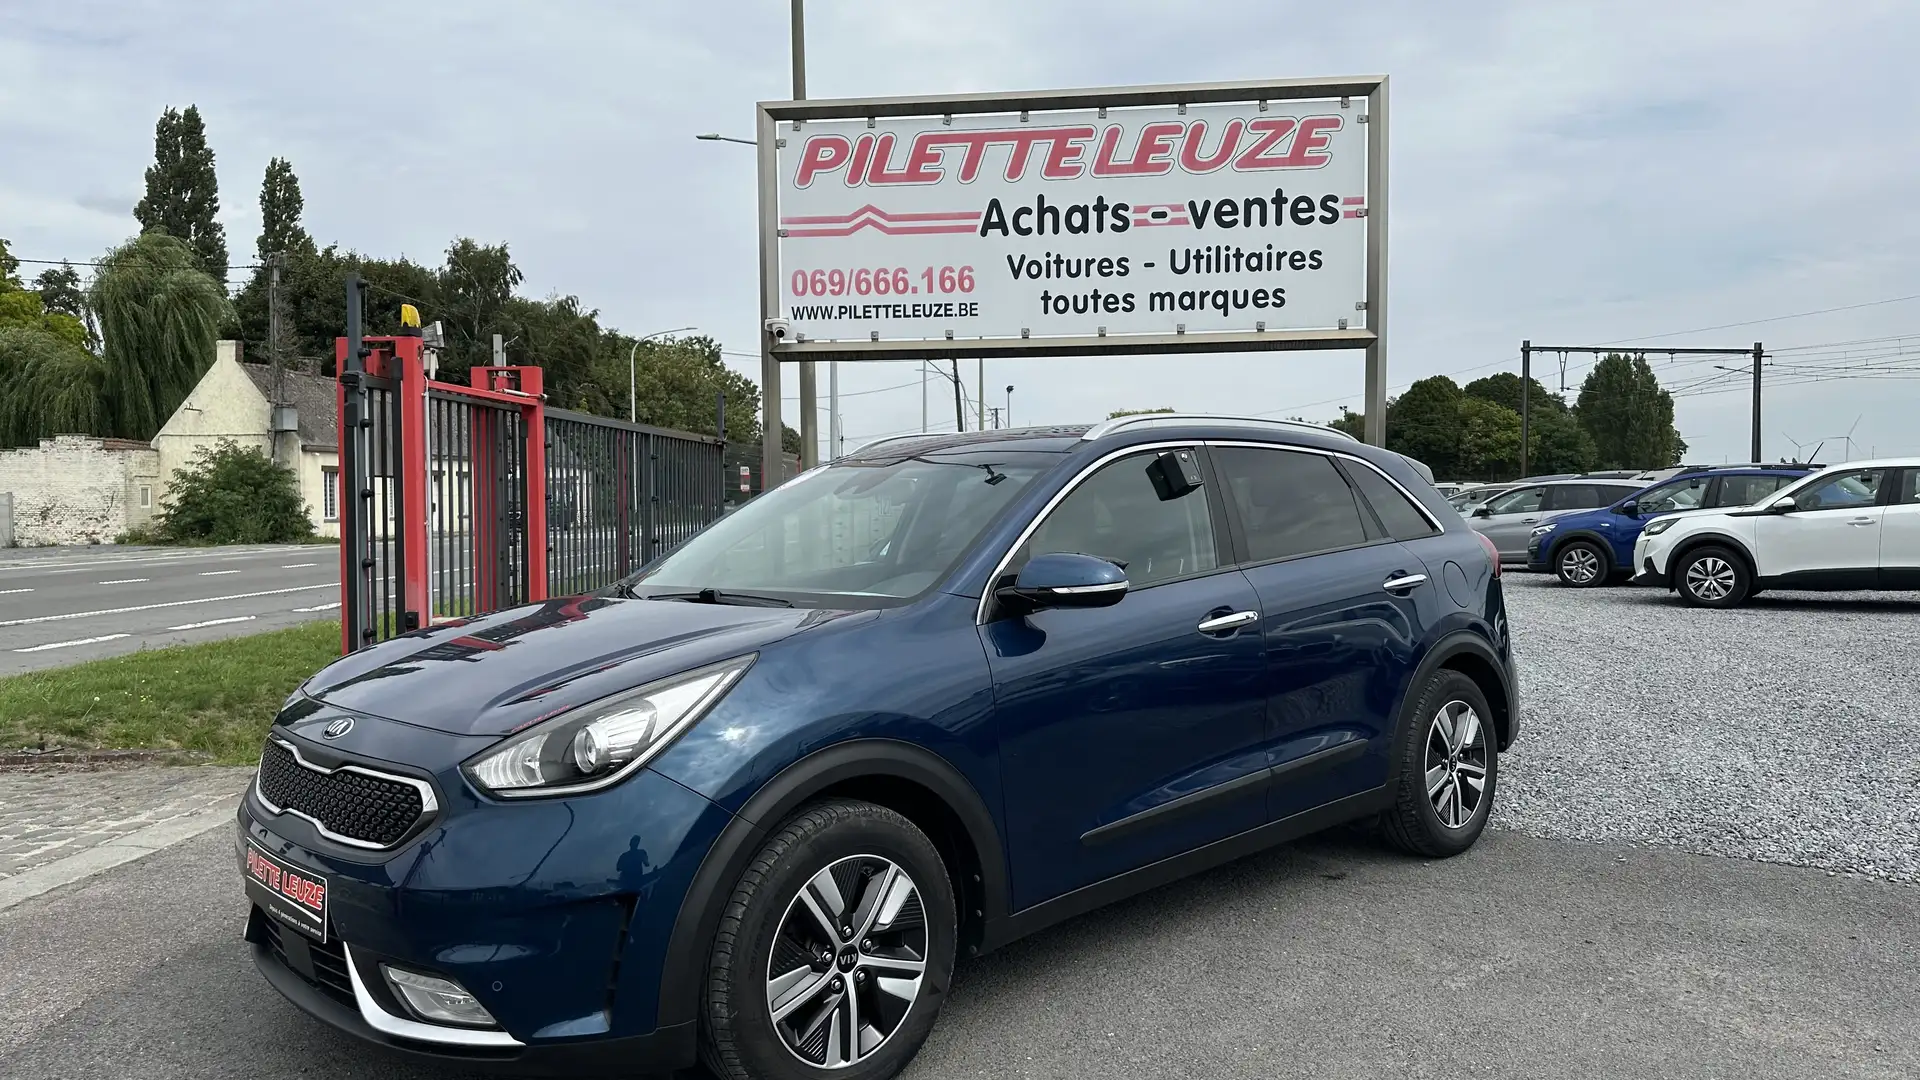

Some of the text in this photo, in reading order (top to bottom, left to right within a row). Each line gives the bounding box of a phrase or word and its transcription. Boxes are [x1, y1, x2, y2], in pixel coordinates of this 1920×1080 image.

[980, 188, 1341, 237] Achats - ventes
[1006, 251, 1130, 280] Voitures
[1169, 243, 1324, 275] Utilitaires
[791, 265, 976, 297] 069/666.166
[791, 302, 979, 321] WWW.PILETTELEUZE.BE
[1040, 287, 1287, 317] toutes marques
[246, 847, 325, 911] PILETTE LEUZE
[840, 953, 857, 965] KIA
